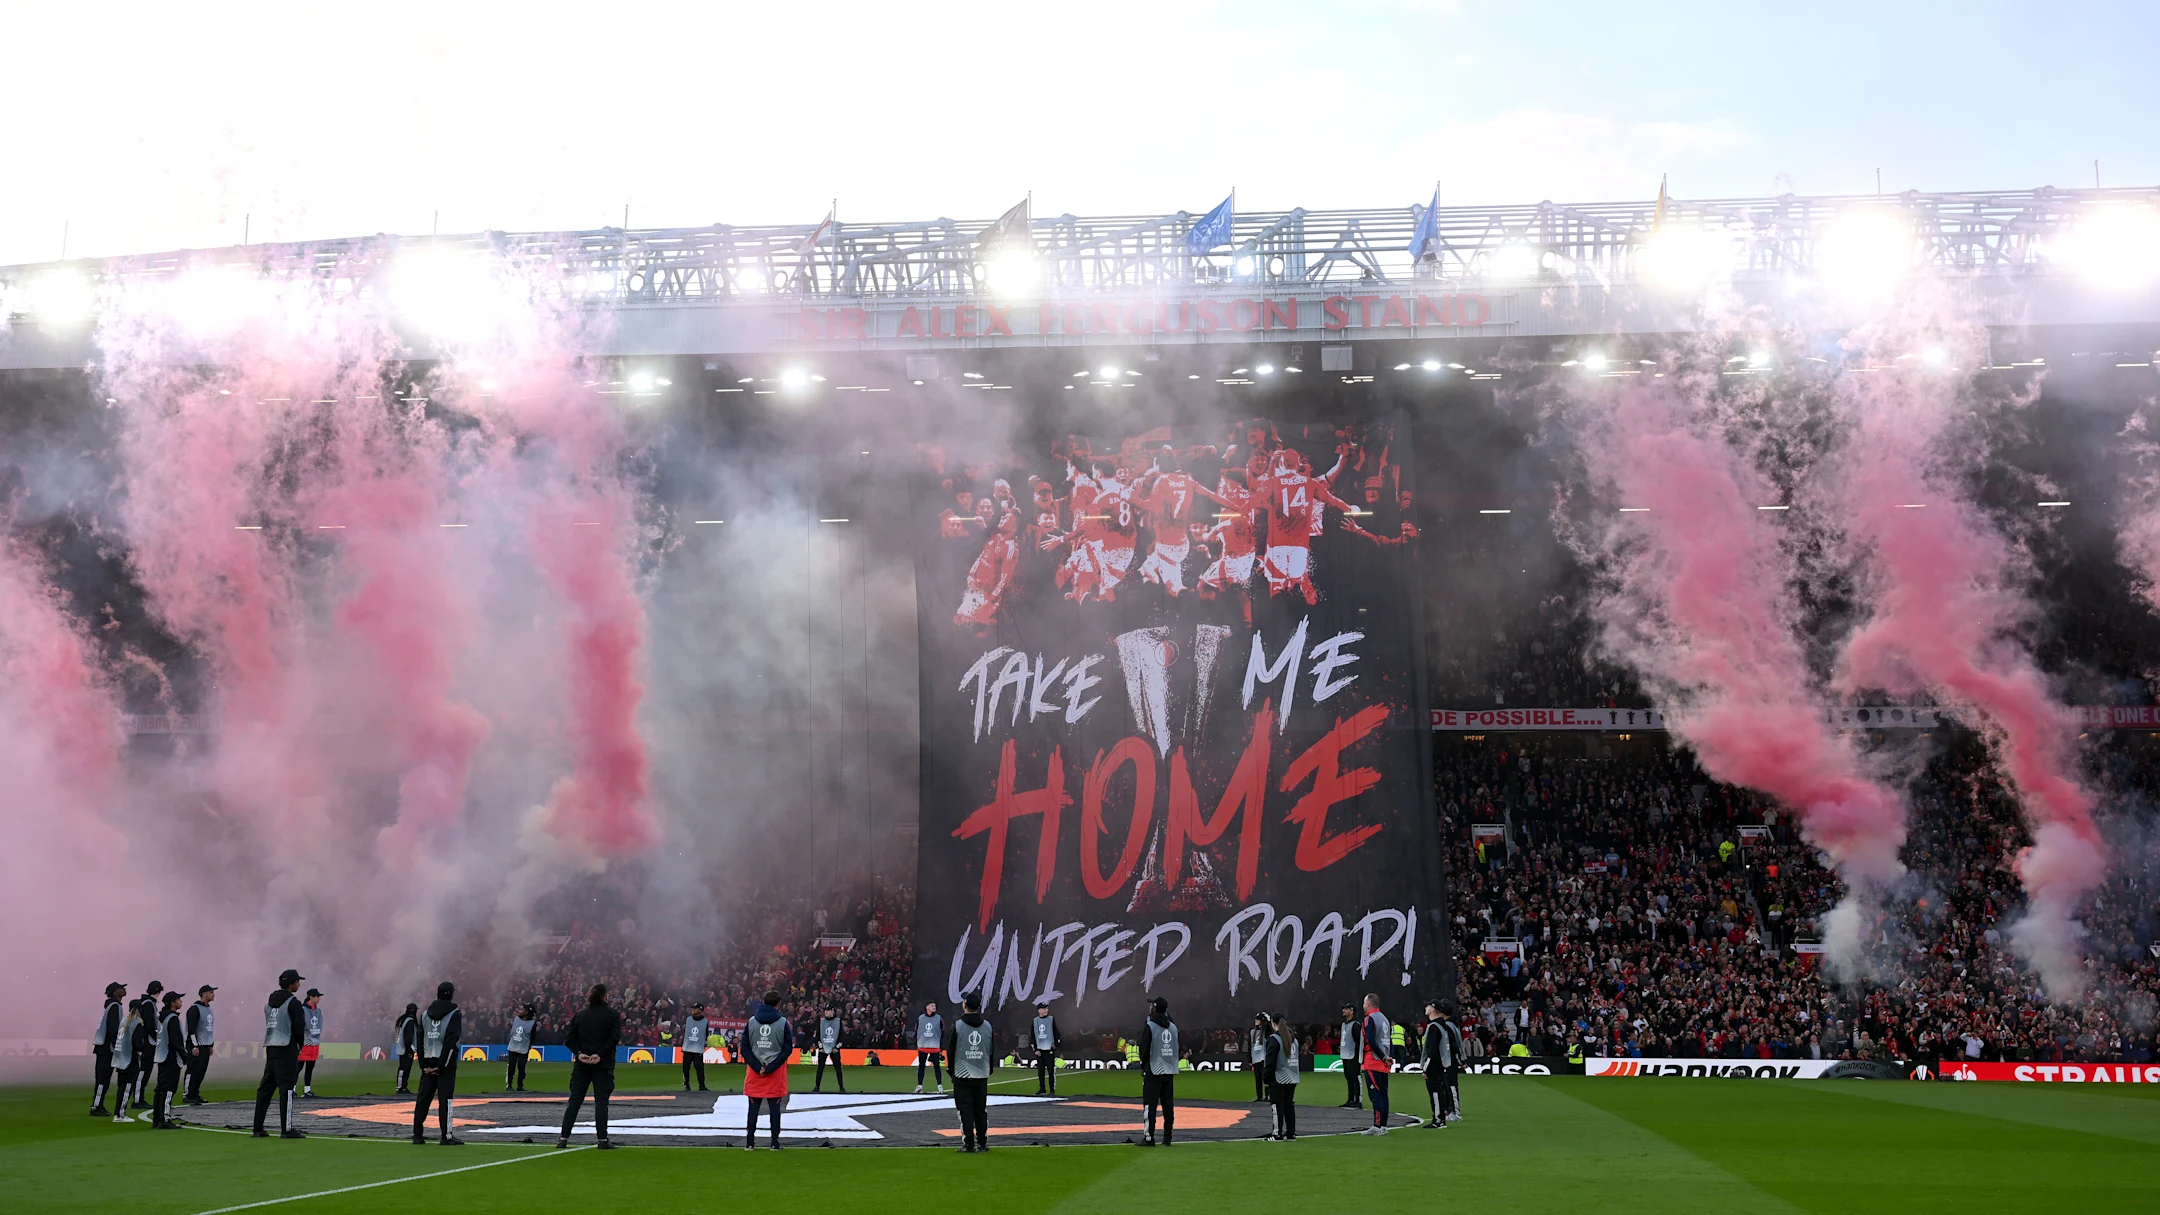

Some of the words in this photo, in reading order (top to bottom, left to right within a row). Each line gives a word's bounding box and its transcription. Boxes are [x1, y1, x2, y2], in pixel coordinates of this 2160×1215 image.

[798, 306, 868, 341] SIR
[895, 304, 1013, 339] ALEX
[1038, 296, 1297, 337] FERGUSON
[1323, 293, 1490, 330] STAND
[1280, 477, 1308, 485] ERIKSEN
[1118, 500, 1131, 527] 8
[1173, 490, 1187, 519] 7
[1281, 486, 1310, 517] 14
[959, 645, 1105, 744] TAKE
[1242, 613, 1366, 737] ME
[2114, 706, 2149, 724] ONE
[951, 698, 1391, 935] HOME
[948, 917, 1192, 1013] UNITED
[1214, 903, 1416, 997] ROAD!
